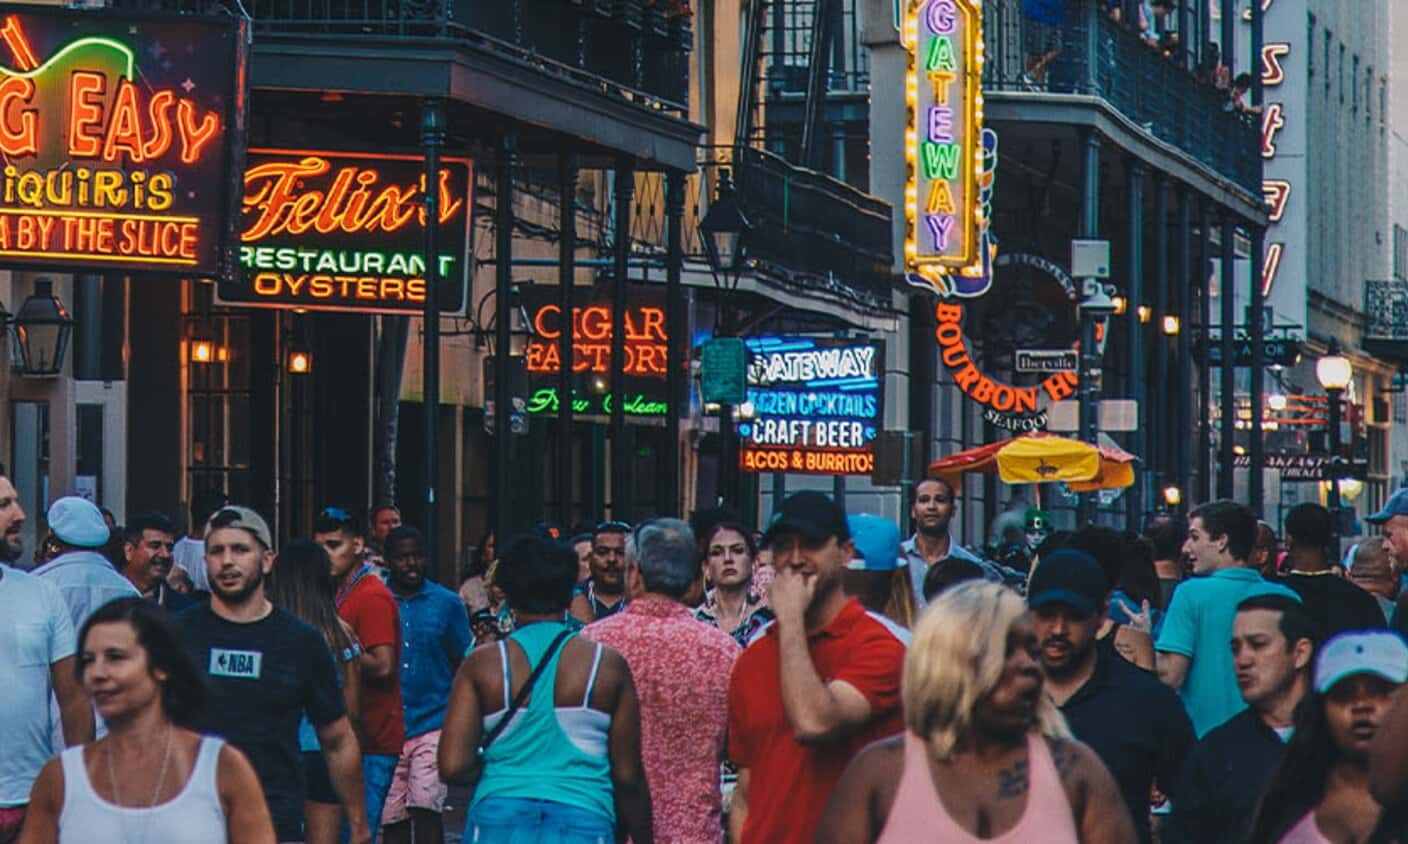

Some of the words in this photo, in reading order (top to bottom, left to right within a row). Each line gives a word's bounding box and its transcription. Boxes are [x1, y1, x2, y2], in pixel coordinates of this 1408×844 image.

[68, 70, 219, 164] EASY
[920, 0, 961, 251] GATEWAY
[16, 214, 56, 250] BY
[60, 216, 114, 253] THE
[118, 218, 199, 259] SLICE
[255, 273, 426, 301] OYSTERS
[534, 304, 668, 341] CIGAR
[935, 301, 1039, 414] BOURBON
[752, 417, 811, 446] CRAFT
[816, 420, 863, 448] BEER
[983, 409, 1049, 431] SEAFOO
[745, 450, 788, 470] ACOS
[792, 450, 803, 470] &
[228, 653, 254, 674] NBA
